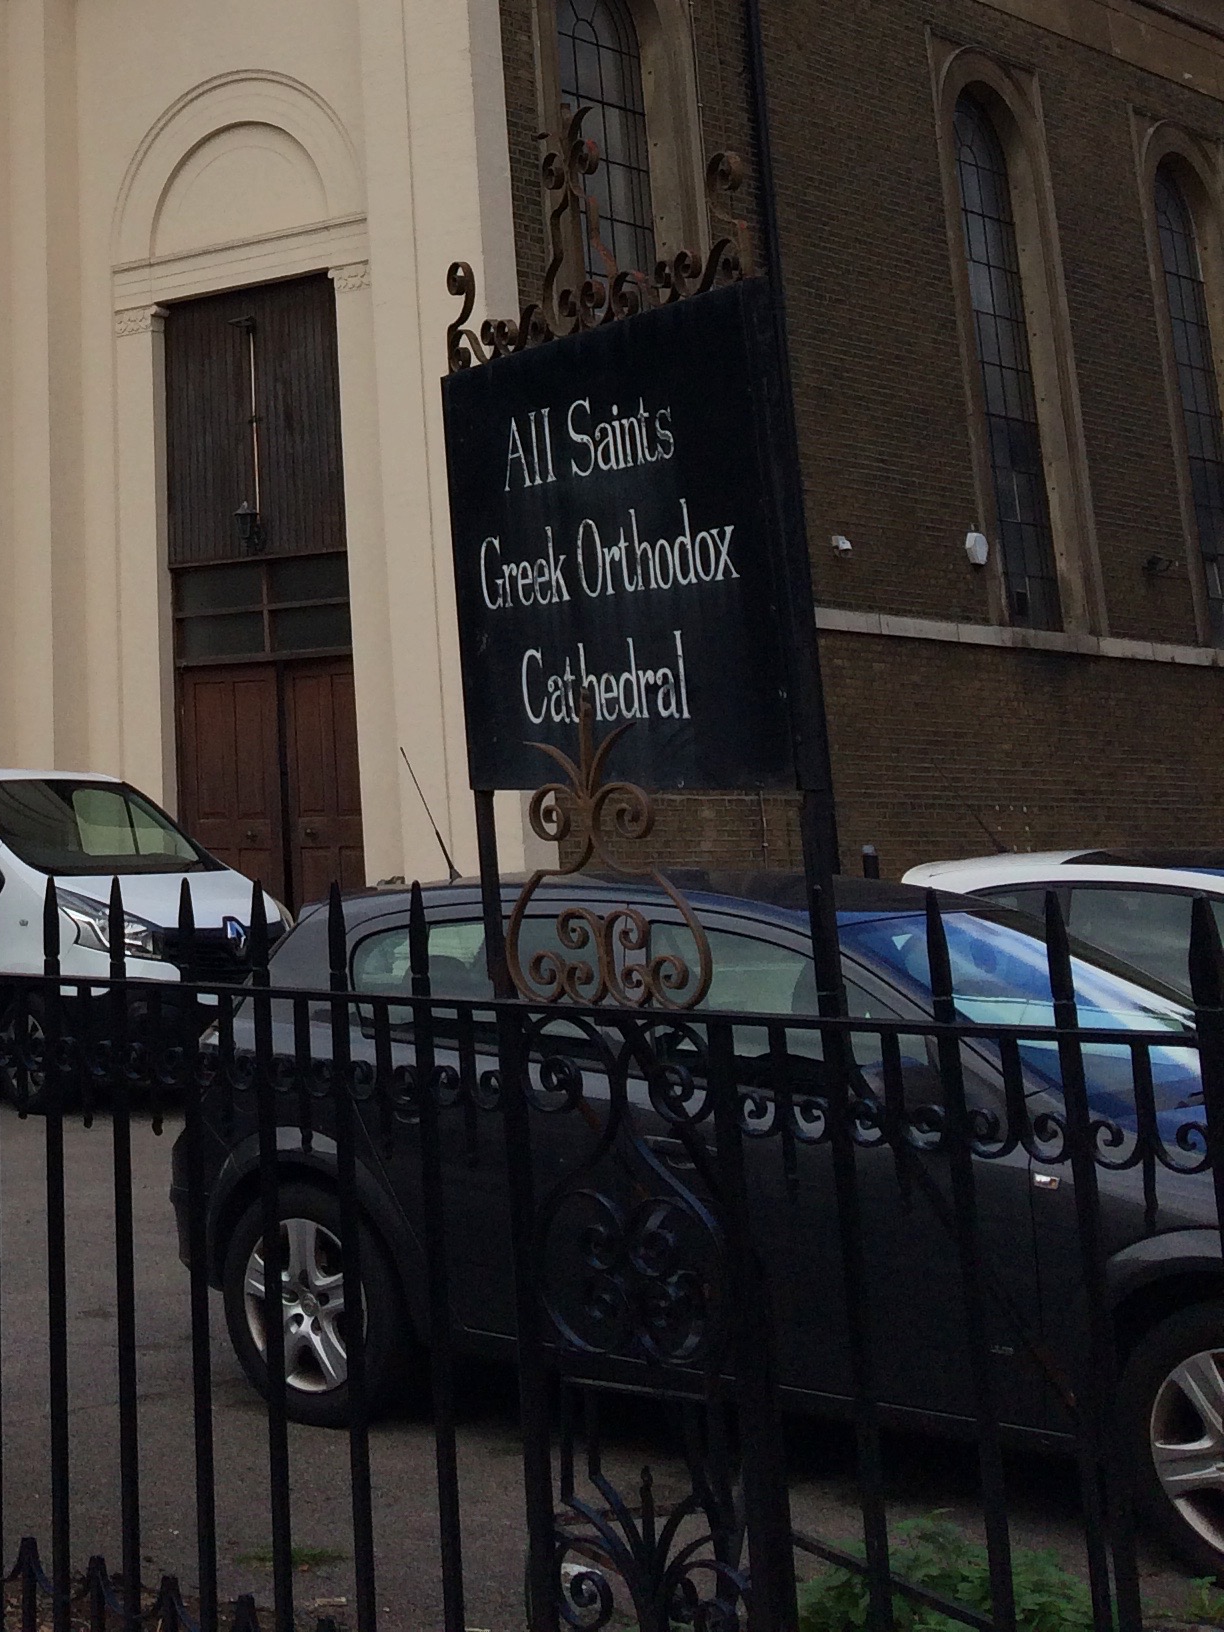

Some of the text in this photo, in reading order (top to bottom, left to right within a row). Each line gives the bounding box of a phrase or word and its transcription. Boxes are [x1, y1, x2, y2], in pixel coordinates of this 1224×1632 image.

[504, 397, 674, 491] All Saints
[480, 499, 740, 610] Greek Orthodox
[522, 630, 691, 724] Cathedral
